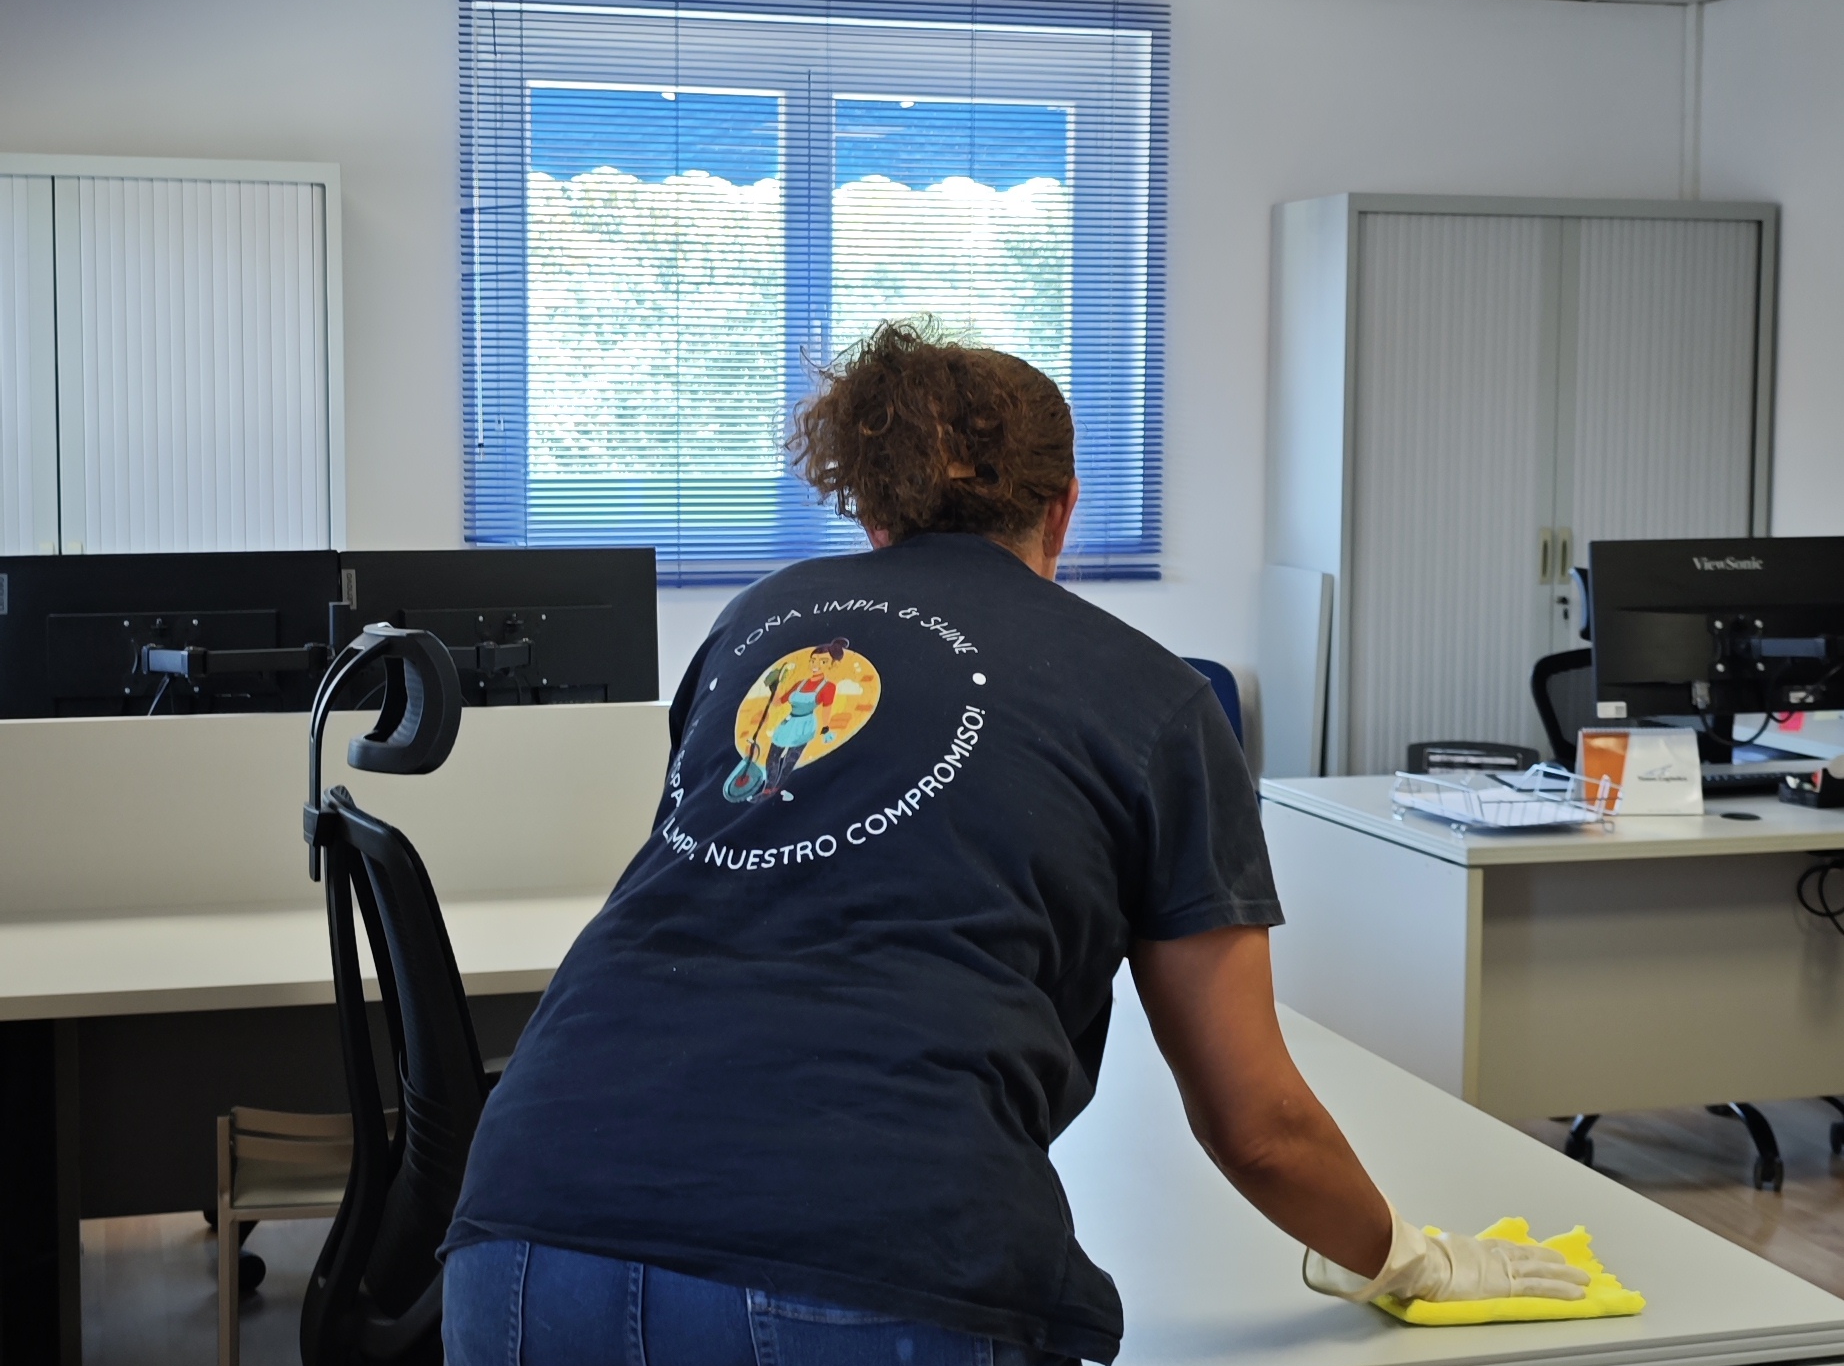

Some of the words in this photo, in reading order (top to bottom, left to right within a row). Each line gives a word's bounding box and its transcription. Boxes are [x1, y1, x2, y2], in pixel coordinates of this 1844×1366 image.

[1692, 556, 1764, 571] ViewSonic
[734, 609, 802, 656] DOÑA
[813, 599, 889, 615] LIMPIA
[898, 607, 920, 619] &
[920, 616, 979, 655] SHINE
[704, 834, 837, 870] NUESTRO
[846, 705, 986, 845] COMPROMISO!
